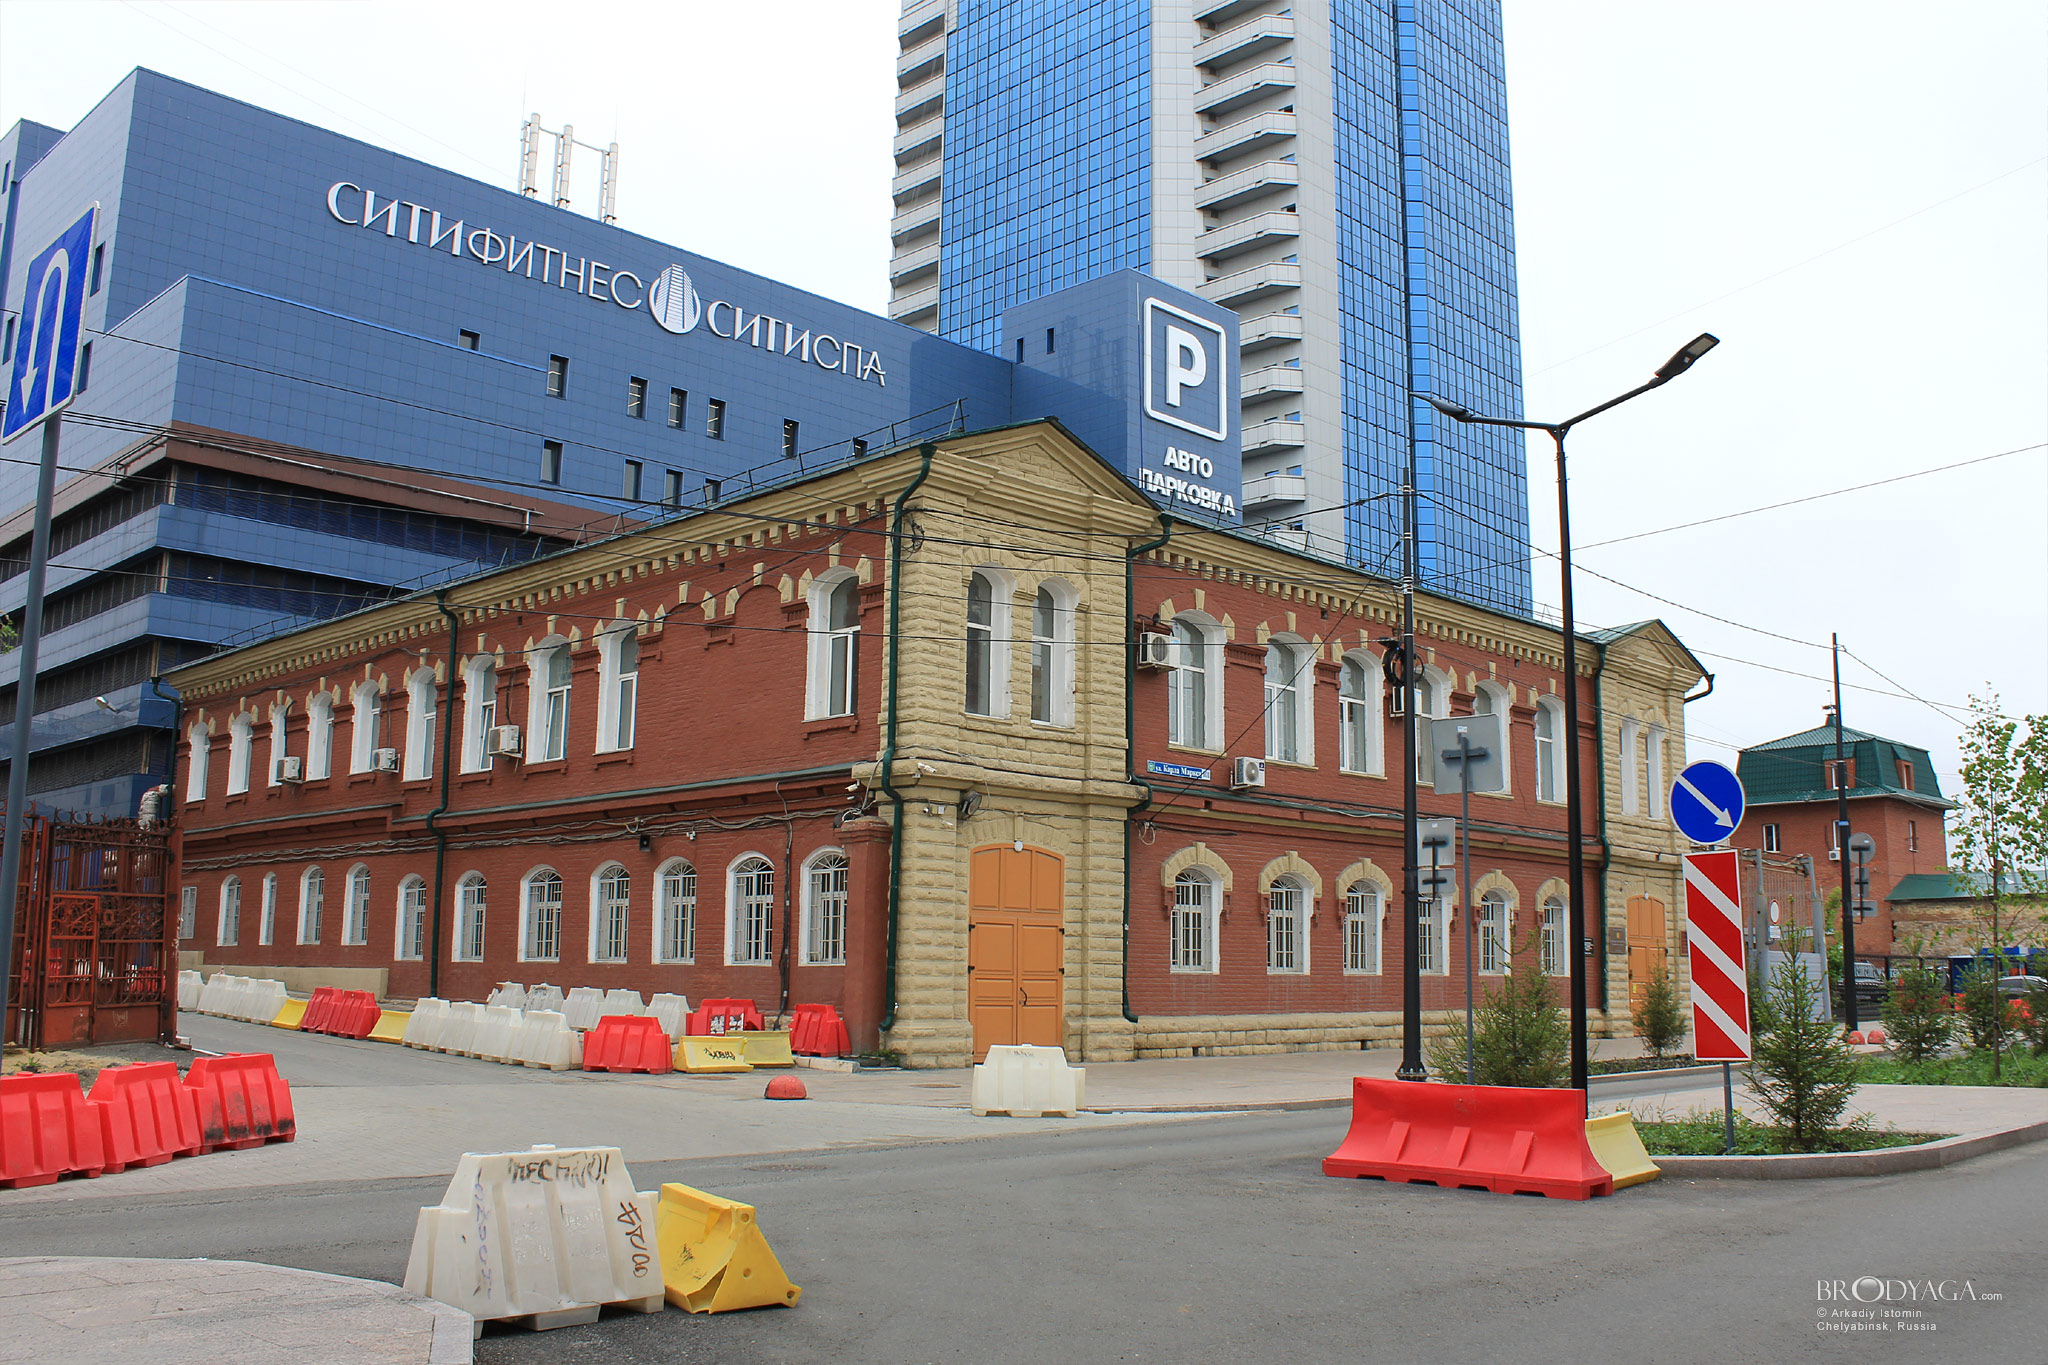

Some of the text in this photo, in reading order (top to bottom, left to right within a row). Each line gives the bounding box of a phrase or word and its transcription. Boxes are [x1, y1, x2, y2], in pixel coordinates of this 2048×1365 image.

[326, 181, 887, 387] СИТИФИТНЕС СИТИСПА
[1165, 324, 1207, 407] P
[1163, 446, 1214, 479] АВТО
[1137, 468, 1236, 517] ПАРКОВКА
[1163, 764, 1180, 775] Карла
